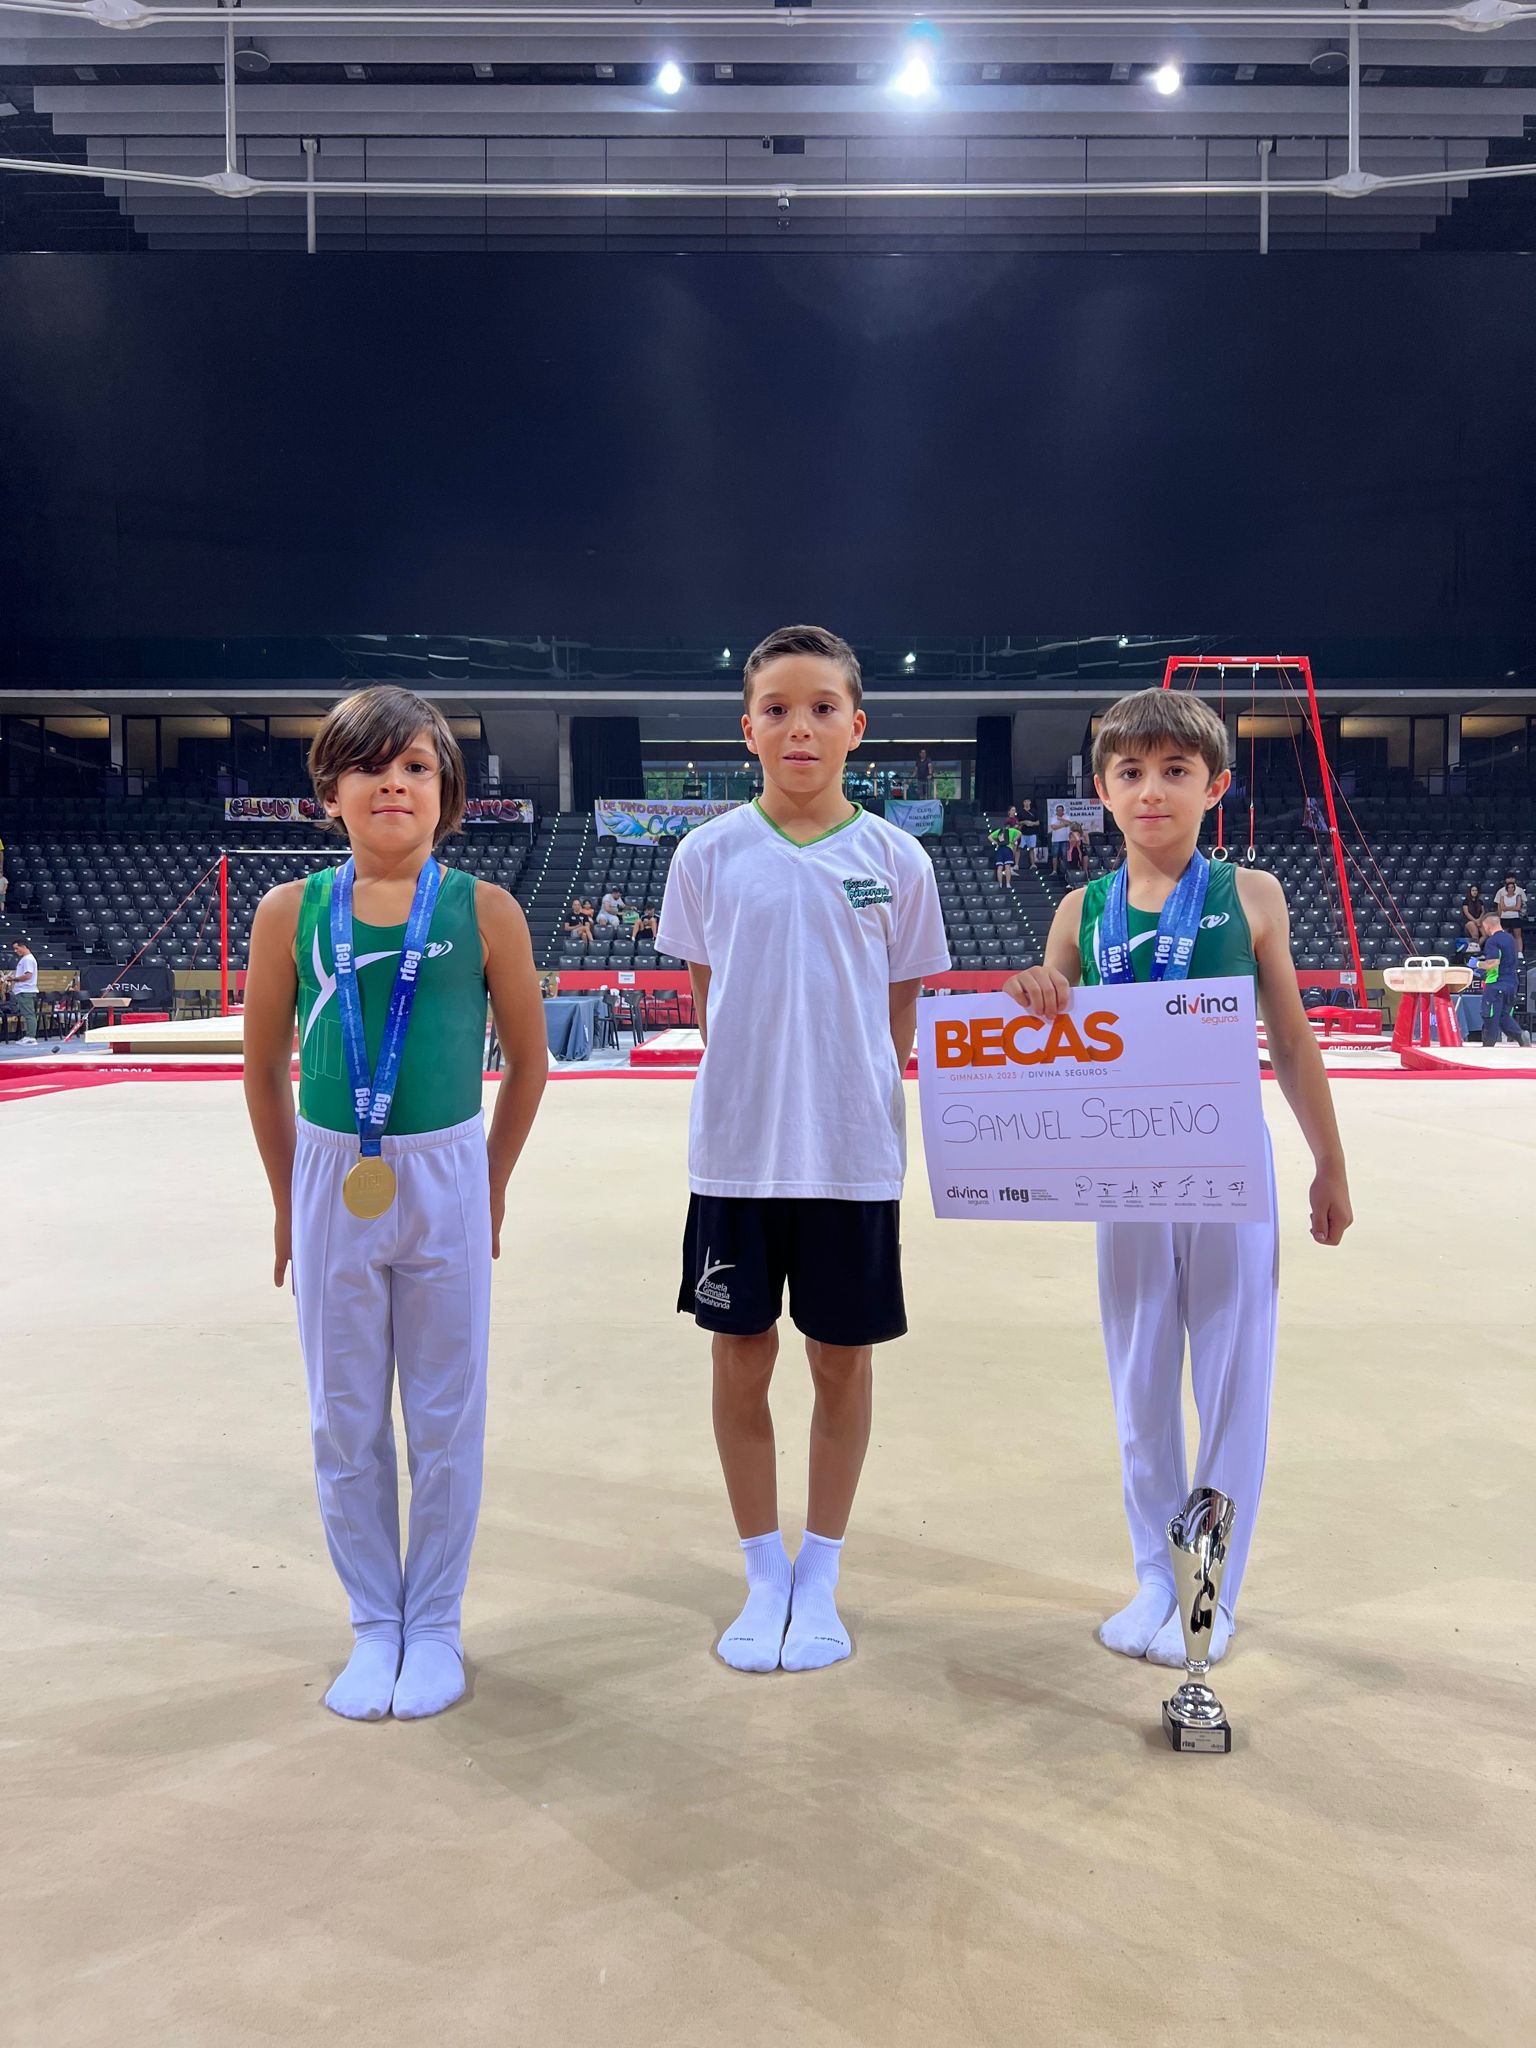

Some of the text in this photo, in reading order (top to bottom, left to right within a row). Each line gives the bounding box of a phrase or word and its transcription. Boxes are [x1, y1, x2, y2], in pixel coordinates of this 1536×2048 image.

[335, 943, 352, 974] rfeg
[1108, 946, 1123, 974] rfeg
[1155, 936, 1173, 964] rfeg
[1173, 937, 1194, 966] rfeg
[400, 950, 422, 982] rfeg
[1166, 993, 1239, 1016] divina
[1201, 1015, 1240, 1026] seguros
[935, 1011, 1125, 1069] BECAS
[950, 1073, 993, 1081] GIMNASIA
[1028, 1070, 1061, 1079] DIVINA
[1064, 1068, 1108, 1077] SEGUROS
[355, 1088, 371, 1120] rfeg
[369, 1092, 391, 1125] rfeg
[941, 1097, 1220, 1143] SAMUEL SEDEÑO
[947, 1186, 989, 1199] divina
[999, 1187, 1030, 1203] rfeg
[703, 1287, 730, 1299] Gimnasia
[705, 1278, 728, 1291] Escuela
